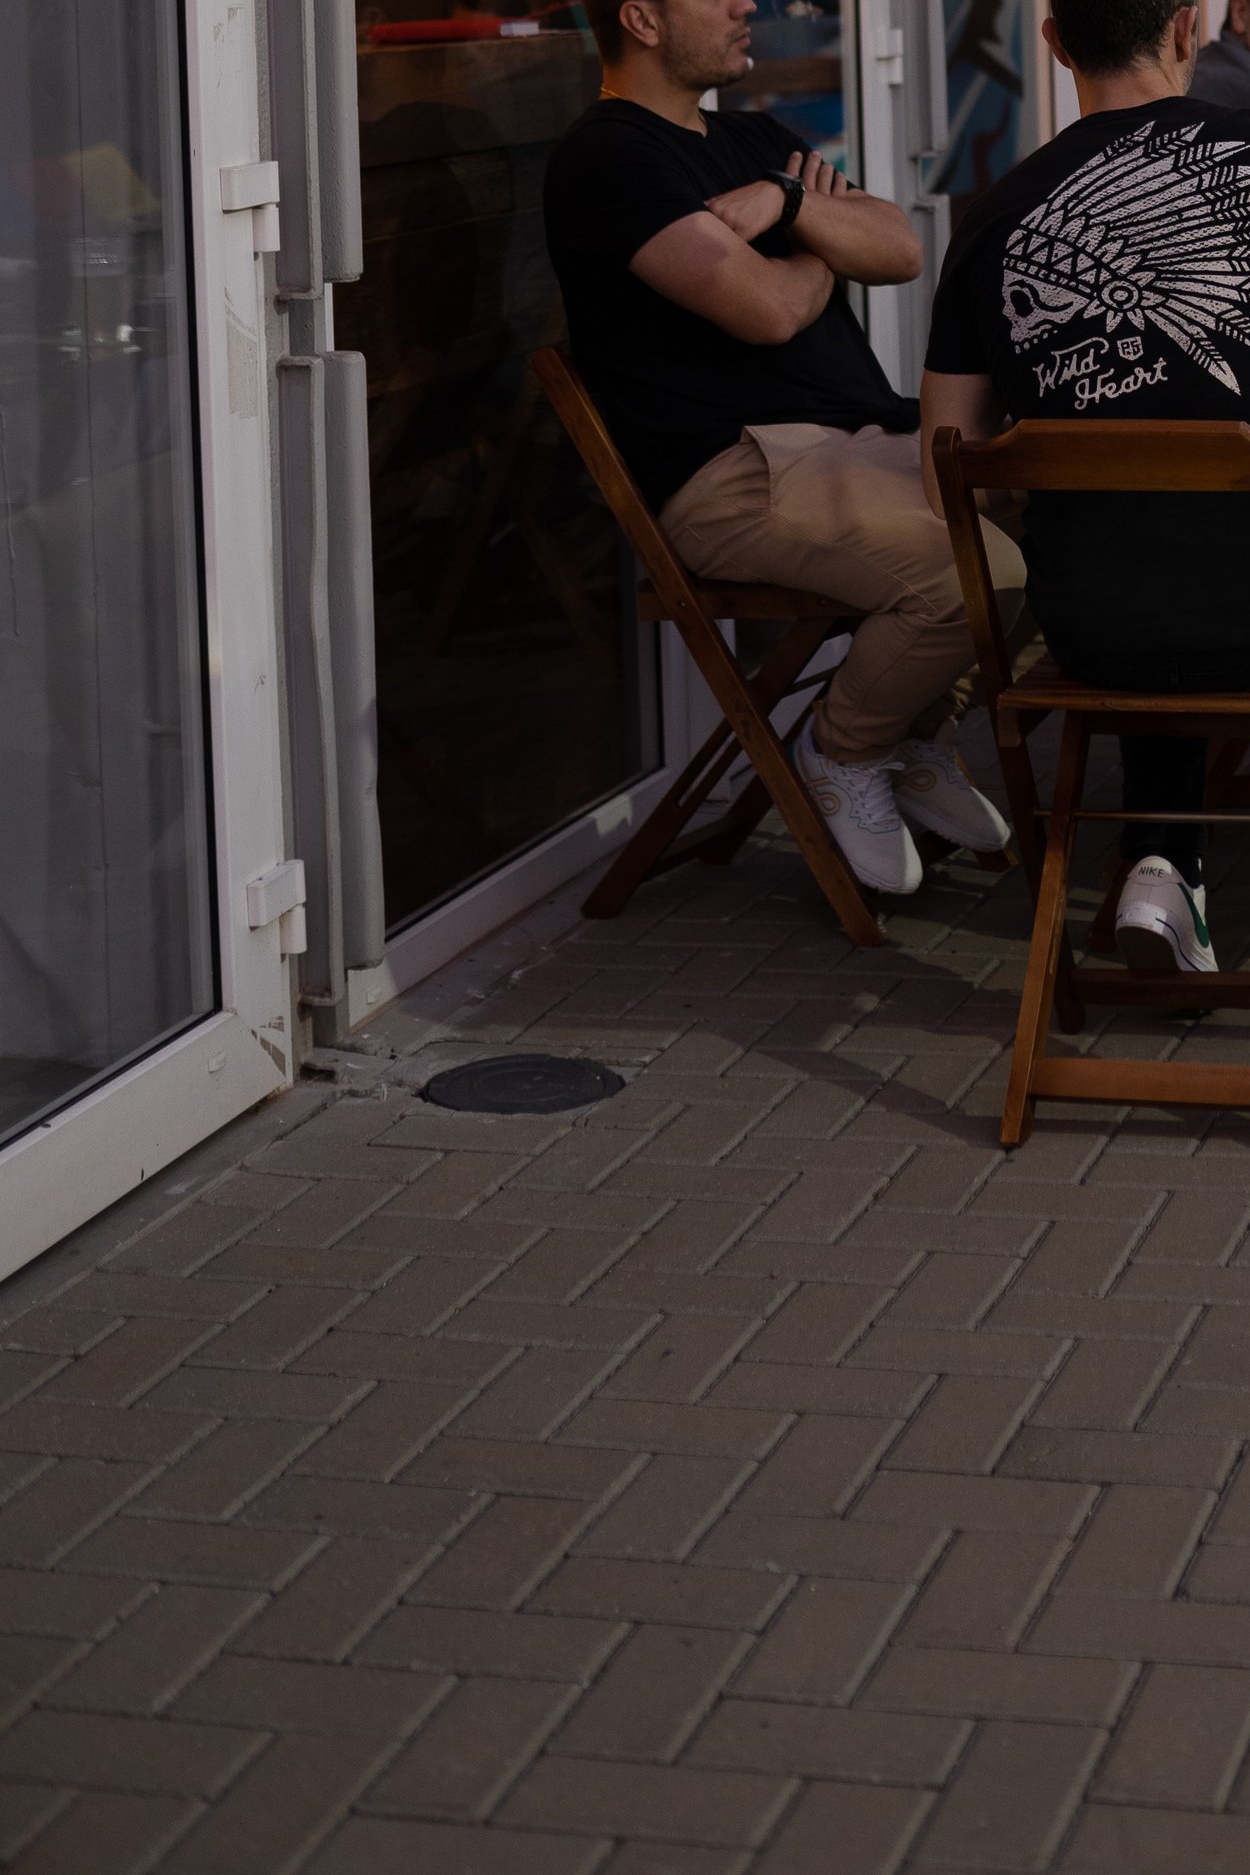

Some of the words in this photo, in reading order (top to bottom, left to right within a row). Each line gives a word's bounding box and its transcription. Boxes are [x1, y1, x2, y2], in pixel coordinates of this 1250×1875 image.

[1032, 336, 1110, 398] Wild
[1074, 357, 1168, 410] Heart
[1139, 866, 1165, 878] NIKE
